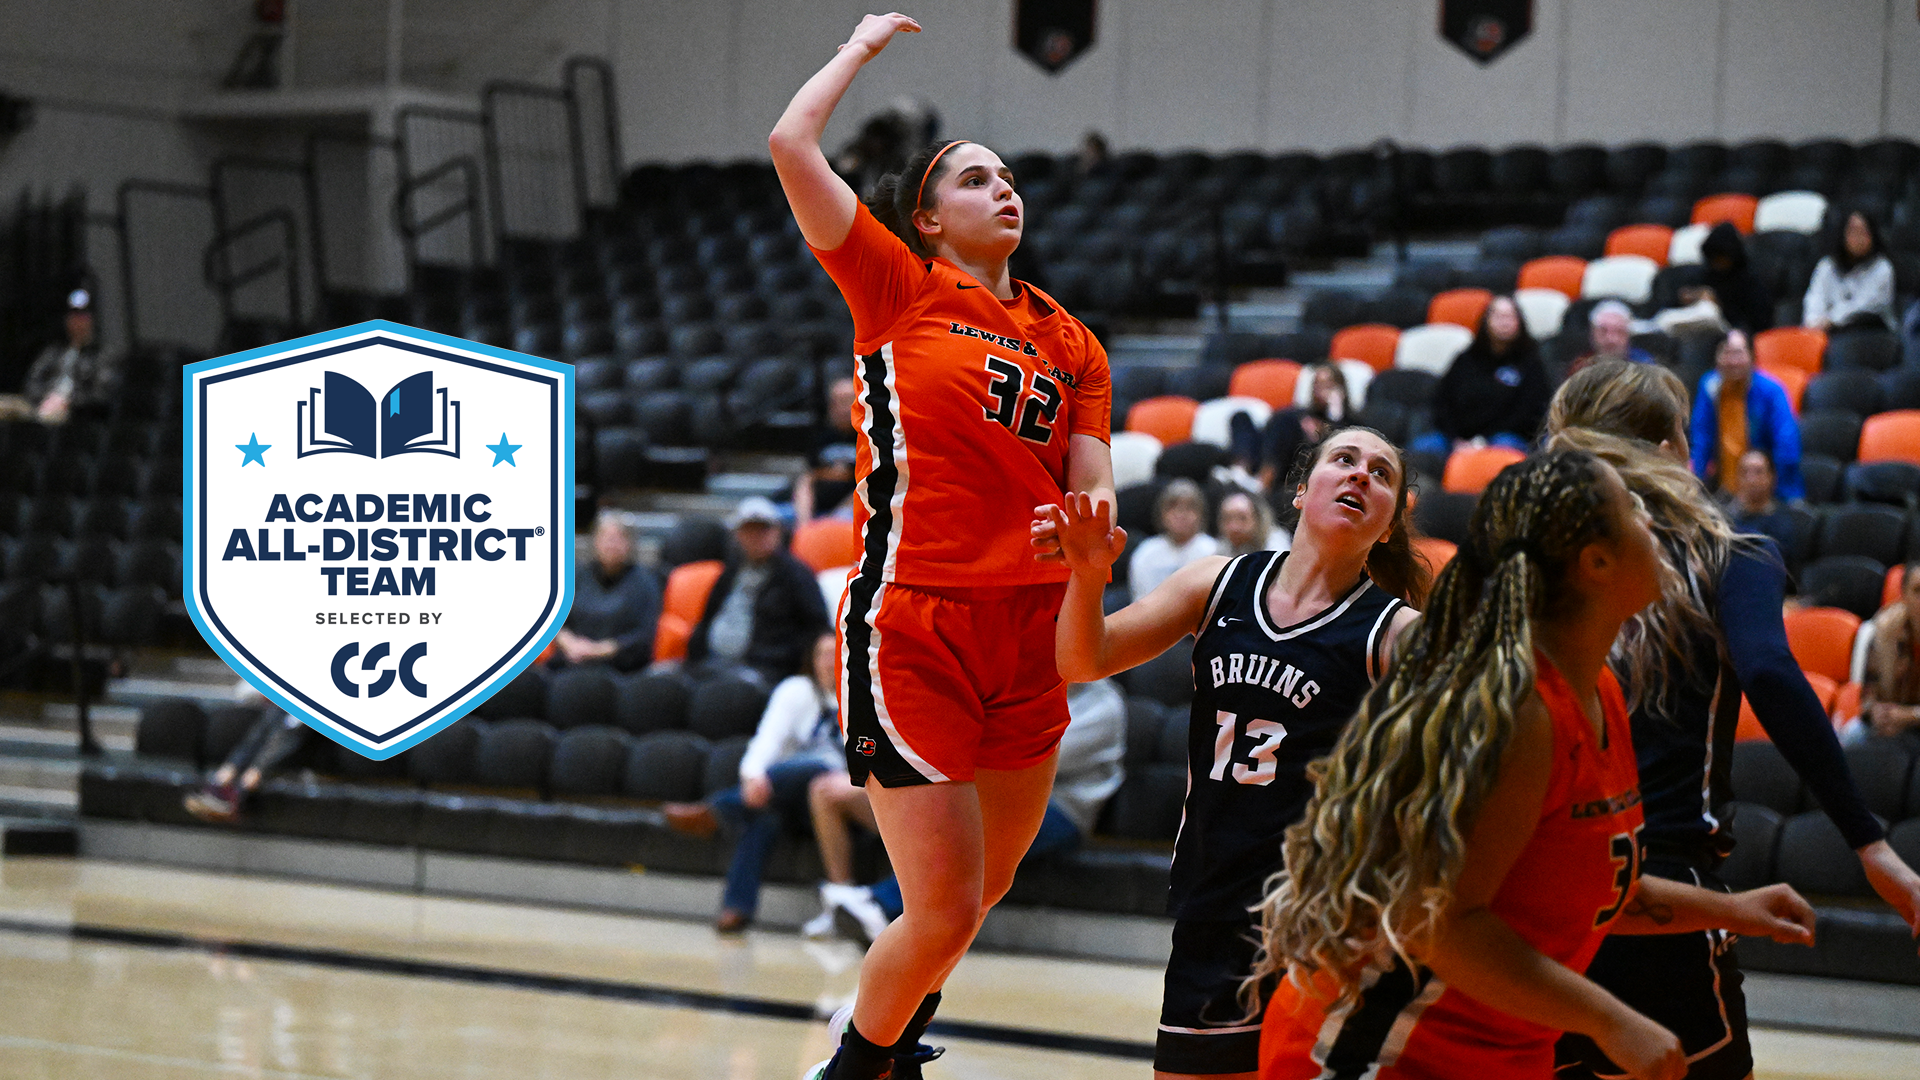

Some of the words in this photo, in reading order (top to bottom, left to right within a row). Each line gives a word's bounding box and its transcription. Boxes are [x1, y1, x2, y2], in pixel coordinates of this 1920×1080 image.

[949, 322, 1021, 351] LEWIS
[1022, 340, 1038, 357] &
[981, 354, 1063, 446] 32
[1210, 653, 1321, 709] BRUINS
[1209, 709, 1288, 787] 13
[1592, 822, 1647, 931] 3
